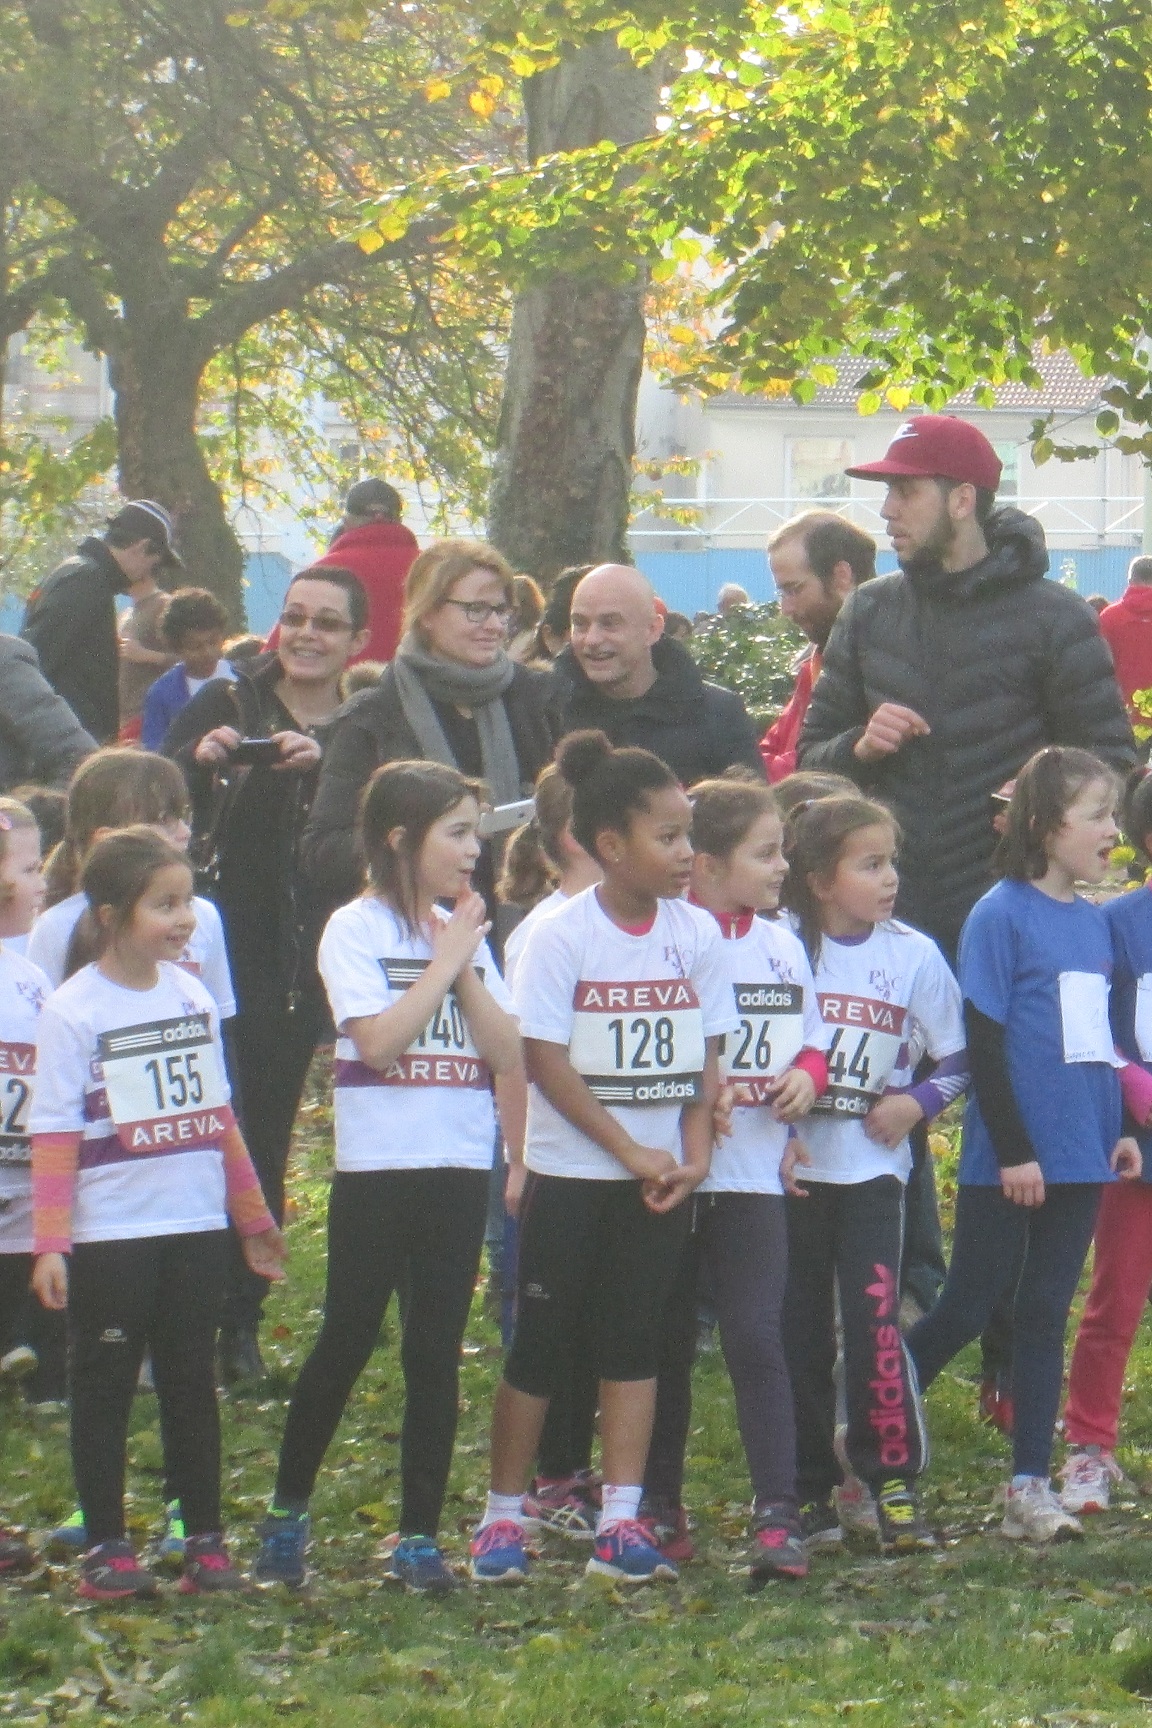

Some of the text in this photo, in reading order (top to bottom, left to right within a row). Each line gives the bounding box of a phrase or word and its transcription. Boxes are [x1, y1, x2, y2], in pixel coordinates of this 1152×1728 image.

[583, 984, 691, 1008] AREVA
[738, 988, 793, 1008] adidas
[823, 998, 894, 1029] REVA
[608, 1016, 674, 1070] 128
[145, 1052, 203, 1111] 155
[385, 1060, 480, 1082] AREVA
[0, 1078, 29, 1132] 2
[635, 1080, 696, 1100] adidas
[132, 1113, 226, 1147] AREVA
[870, 1324, 909, 1467] adidas
